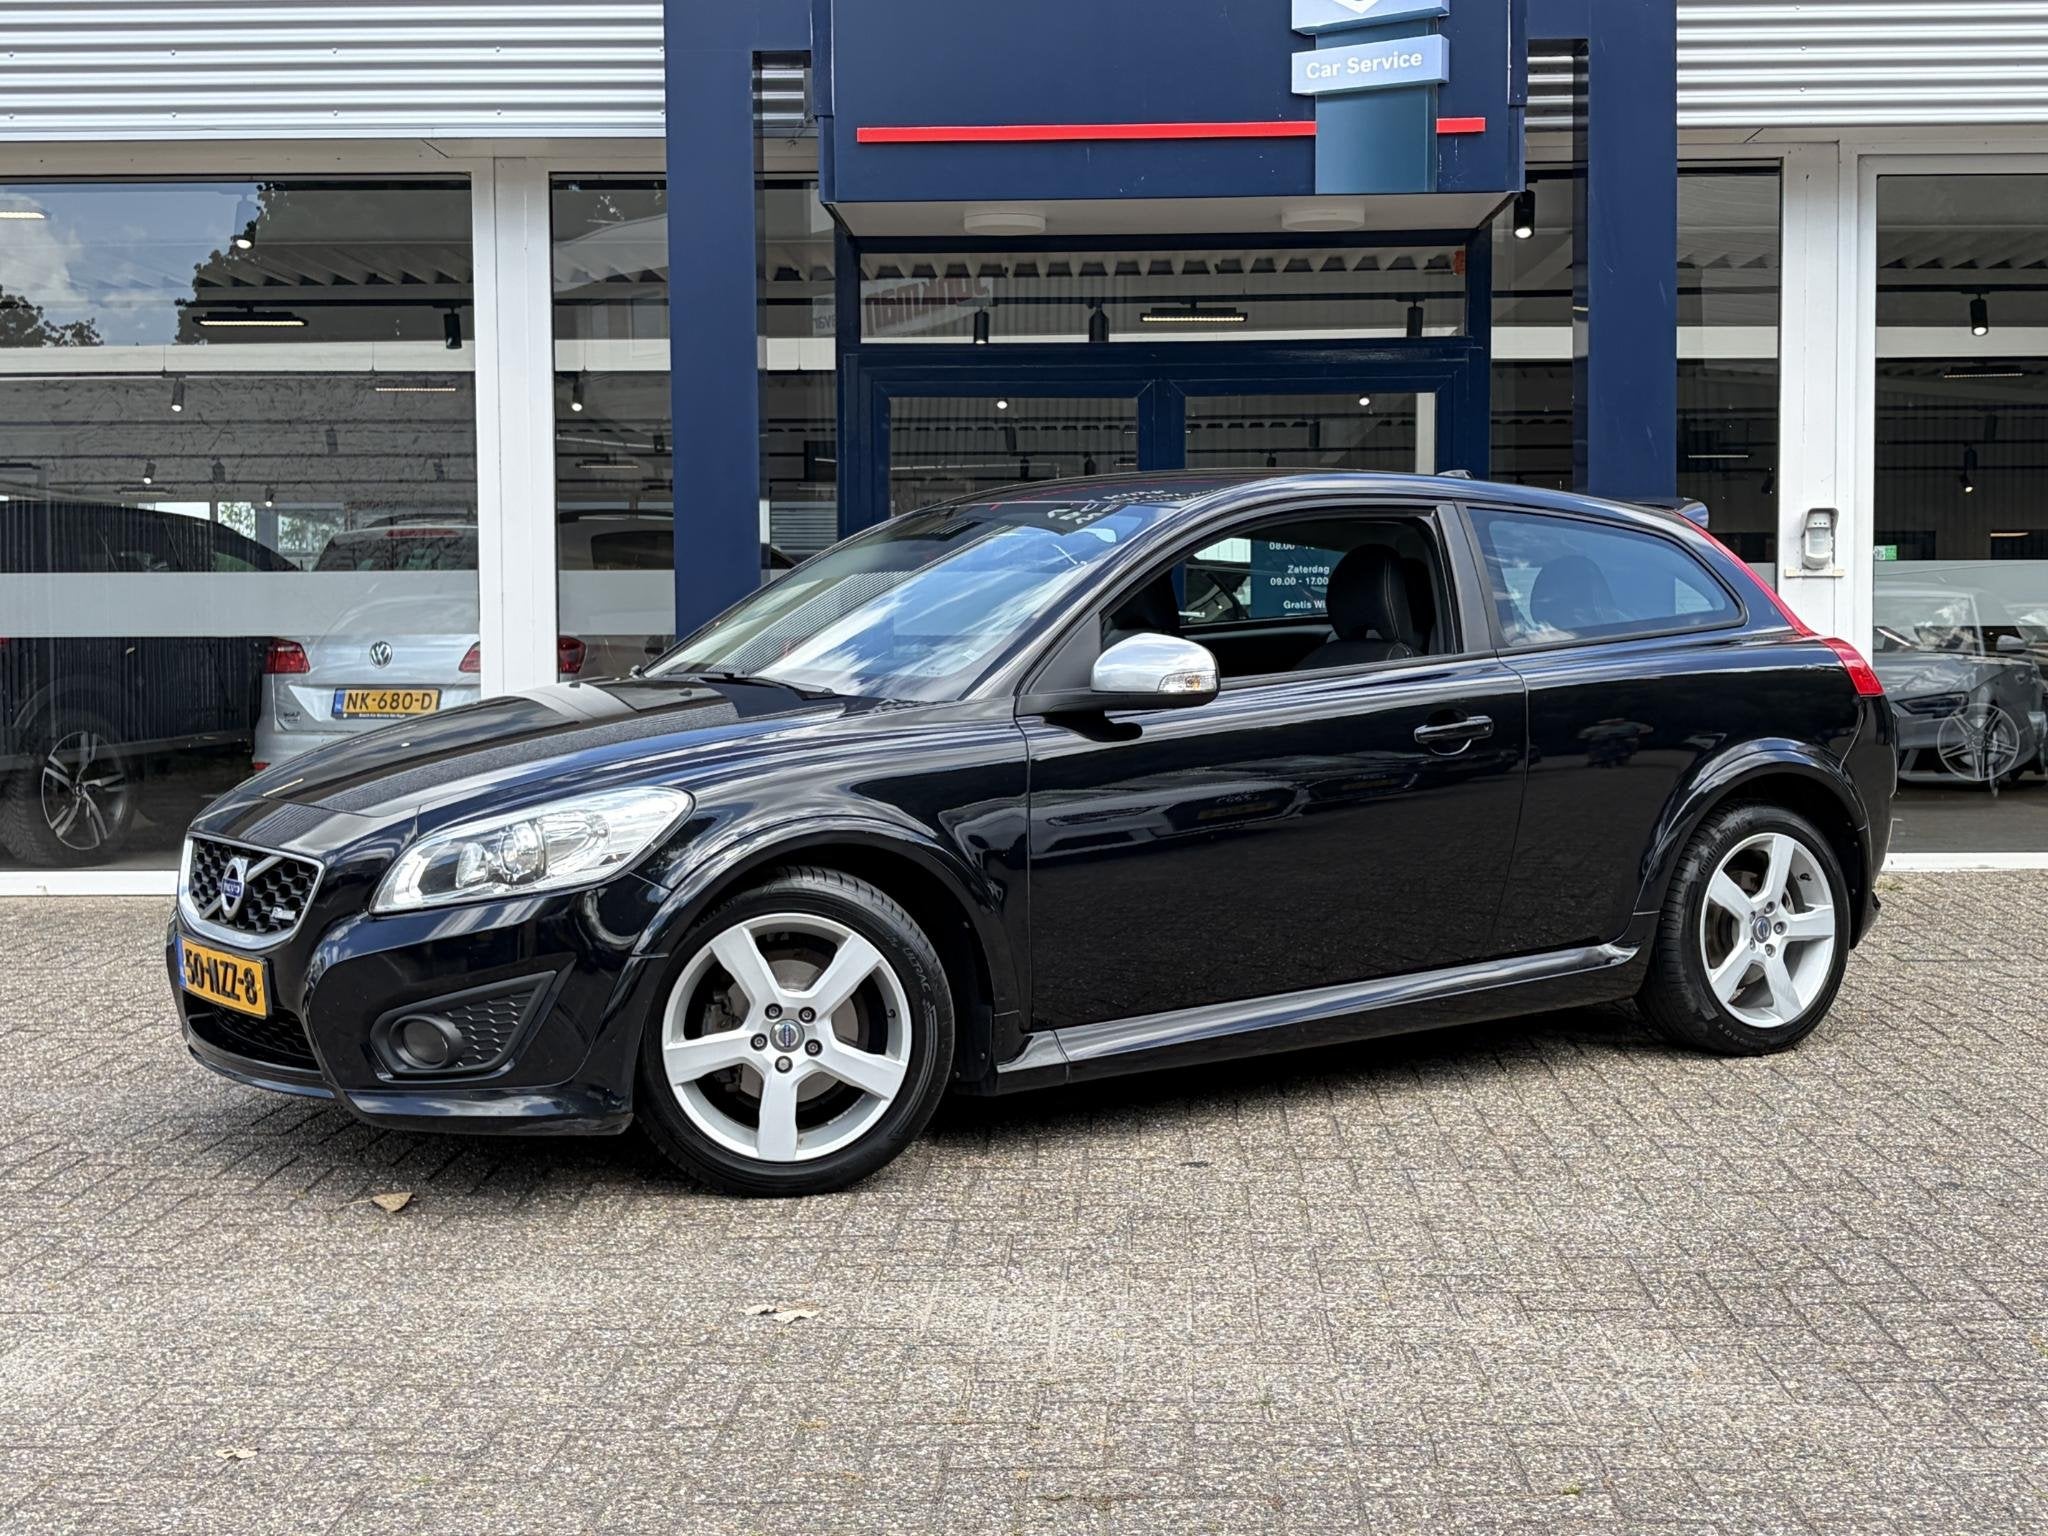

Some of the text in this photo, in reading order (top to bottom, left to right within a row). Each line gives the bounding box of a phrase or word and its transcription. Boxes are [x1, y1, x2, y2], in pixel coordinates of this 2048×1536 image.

[1306, 50, 1423, 80] Car Service
[1287, 564, 1330, 575] Zaterdag
[1270, 577, 1296, 585] 09.00
[1305, 577, 1329, 585] 17.00
[1283, 600, 1312, 609] Gratis
[345, 691, 433, 711] NK-680-D
[184, 948, 258, 1005] 50-NZZ-8
